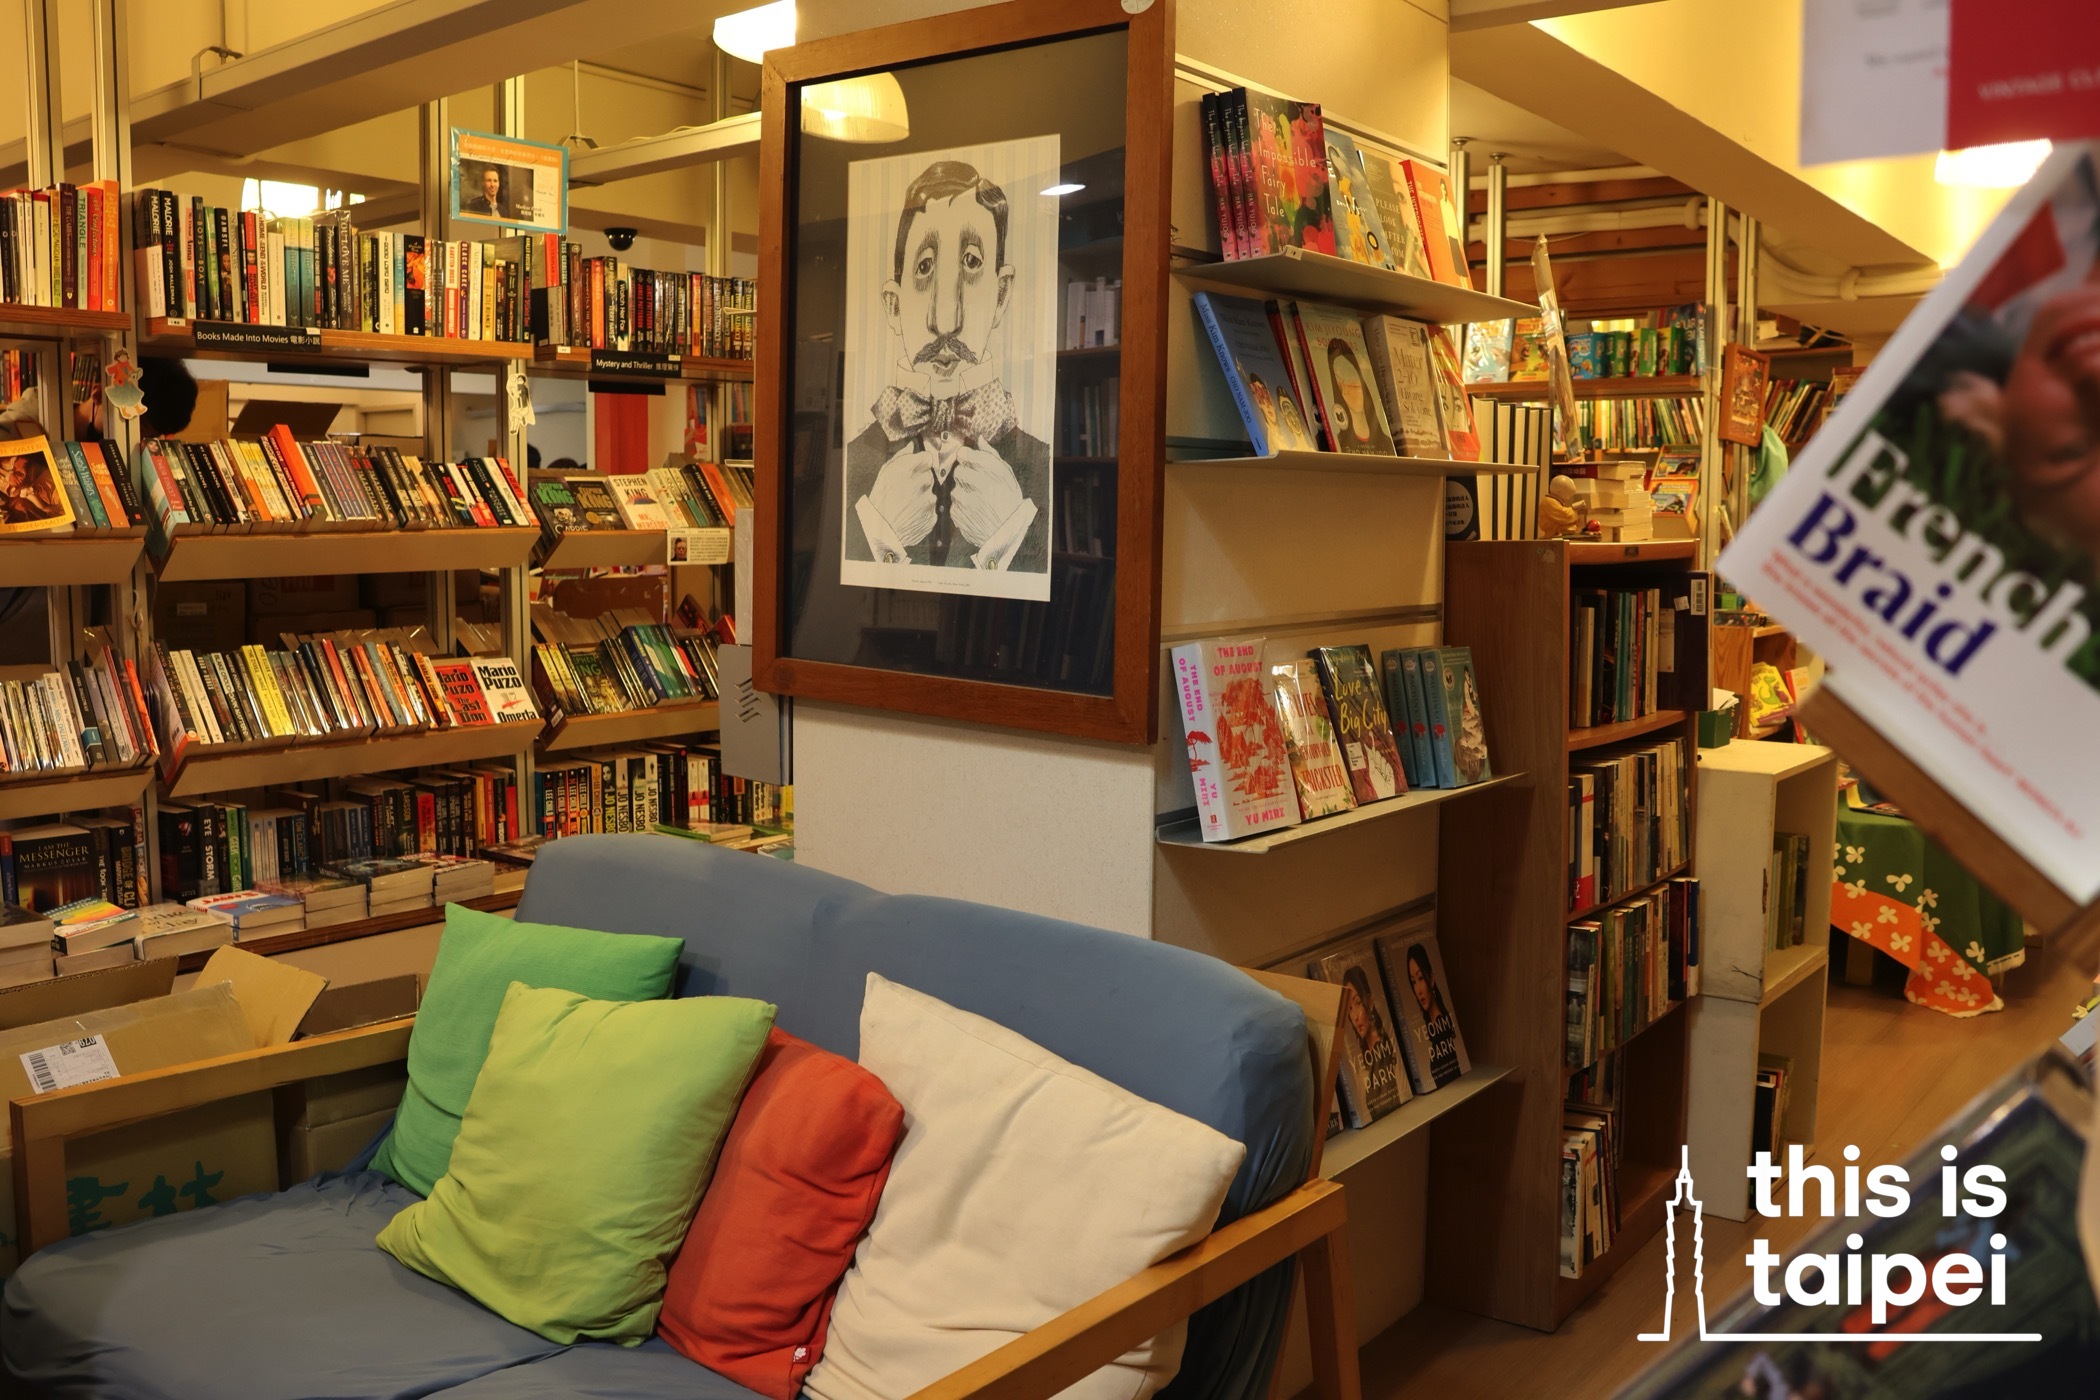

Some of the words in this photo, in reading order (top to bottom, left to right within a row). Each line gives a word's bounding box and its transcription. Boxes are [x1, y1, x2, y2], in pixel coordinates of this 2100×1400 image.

[1254, 108, 1273, 132] The
[1258, 138, 1317, 168] Impossible
[1261, 165, 1286, 196] Fairy
[151, 196, 160, 234] MALORIE
[164, 198, 172, 236] MALORIE
[1264, 193, 1285, 217] Tale
[1375, 198, 1401, 214] PLEASE
[197, 332, 221, 341] Books
[222, 333, 244, 342] Made
[246, 334, 260, 342] Into
[262, 335, 289, 344] Movies
[1200, 303, 1211, 325] Miss
[1208, 325, 1219, 346] Kim
[1216, 344, 1230, 373] Knows
[1305, 323, 1323, 333] KIM
[1324, 325, 1361, 339] JIYOUNG
[596, 359, 620, 371] Mystery
[621, 360, 632, 369] and
[633, 360, 653, 370] Thriller
[1394, 346, 1423, 370] Mater
[1397, 369, 1418, 385] 2-10
[613, 477, 648, 488] STEPHEN
[624, 487, 649, 499] KING
[537, 489, 575, 504] KING
[576, 493, 614, 508] KING
[1845, 428, 2093, 661] French
[1786, 489, 2000, 678] Braid
[1217, 647, 1233, 657] THE
[1236, 645, 1254, 657] END
[477, 665, 517, 677] Mario
[1213, 665, 1226, 676] OF
[1229, 661, 1263, 674] AUGUST
[444, 684, 475, 696] Puzo
[483, 675, 522, 690] Puzo
[1178, 657, 1186, 671] OF
[1182, 677, 1195, 722] AUGUST
[1189, 664, 1199, 686] THE
[1194, 689, 1203, 712] END
[1333, 666, 1361, 701] Love
[450, 701, 482, 712] Last
[460, 712, 487, 723] Don
[498, 710, 537, 723] Omerta
[1340, 702, 1361, 738] Big
[1362, 698, 1388, 735] City
[1301, 764, 1345, 792] TRICKSTER
[1199, 778, 1210, 806] MIRI
[402, 790, 412, 821] LARSSON
[1245, 814, 1259, 826] YU
[1261, 807, 1286, 823] MIRI
[204, 819, 212, 837] EYE
[20, 845, 90, 863] MESSENGER
[56, 842, 70, 850] THE
[24, 860, 58, 869] MARKUS
[121, 846, 133, 881] BRIDGE
[205, 845, 214, 880] STORM
[1413, 1012, 1456, 1043] YEONMI
[1349, 1039, 1397, 1074] YEONMI
[1429, 1039, 1456, 1063] PARK
[1364, 1068, 1397, 1094] PARK
